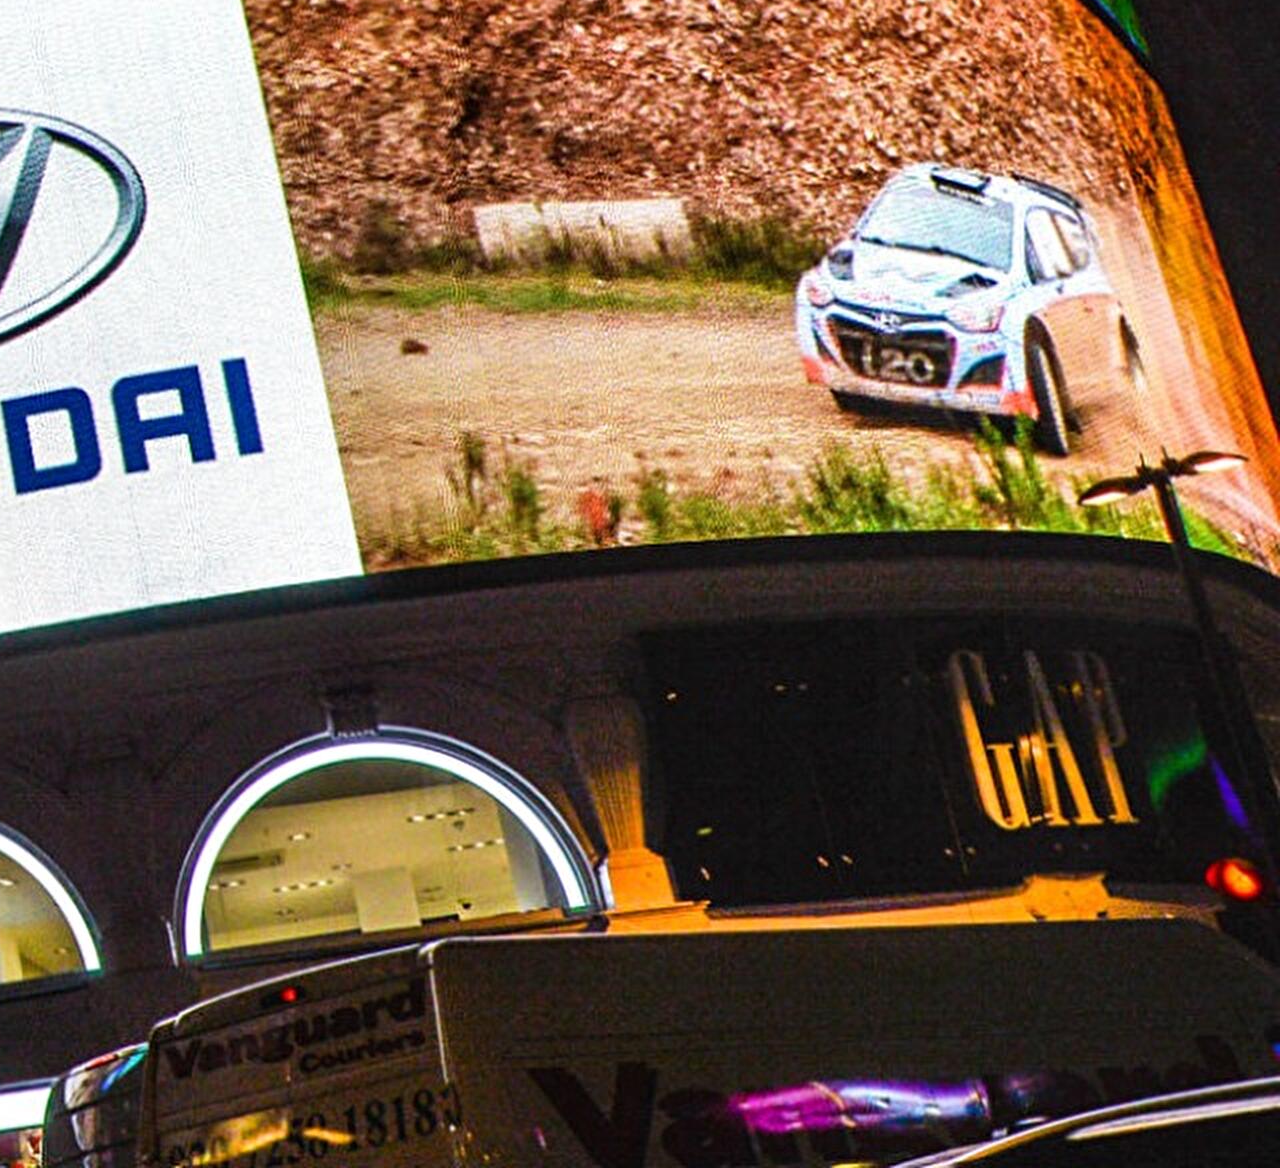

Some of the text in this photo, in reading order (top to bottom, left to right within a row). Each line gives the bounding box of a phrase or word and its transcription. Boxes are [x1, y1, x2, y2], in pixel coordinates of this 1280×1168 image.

[948, 650, 1139, 830] GAP
[164, 977, 427, 1080] Vanguard
[299, 1030, 427, 1074] Couriers
